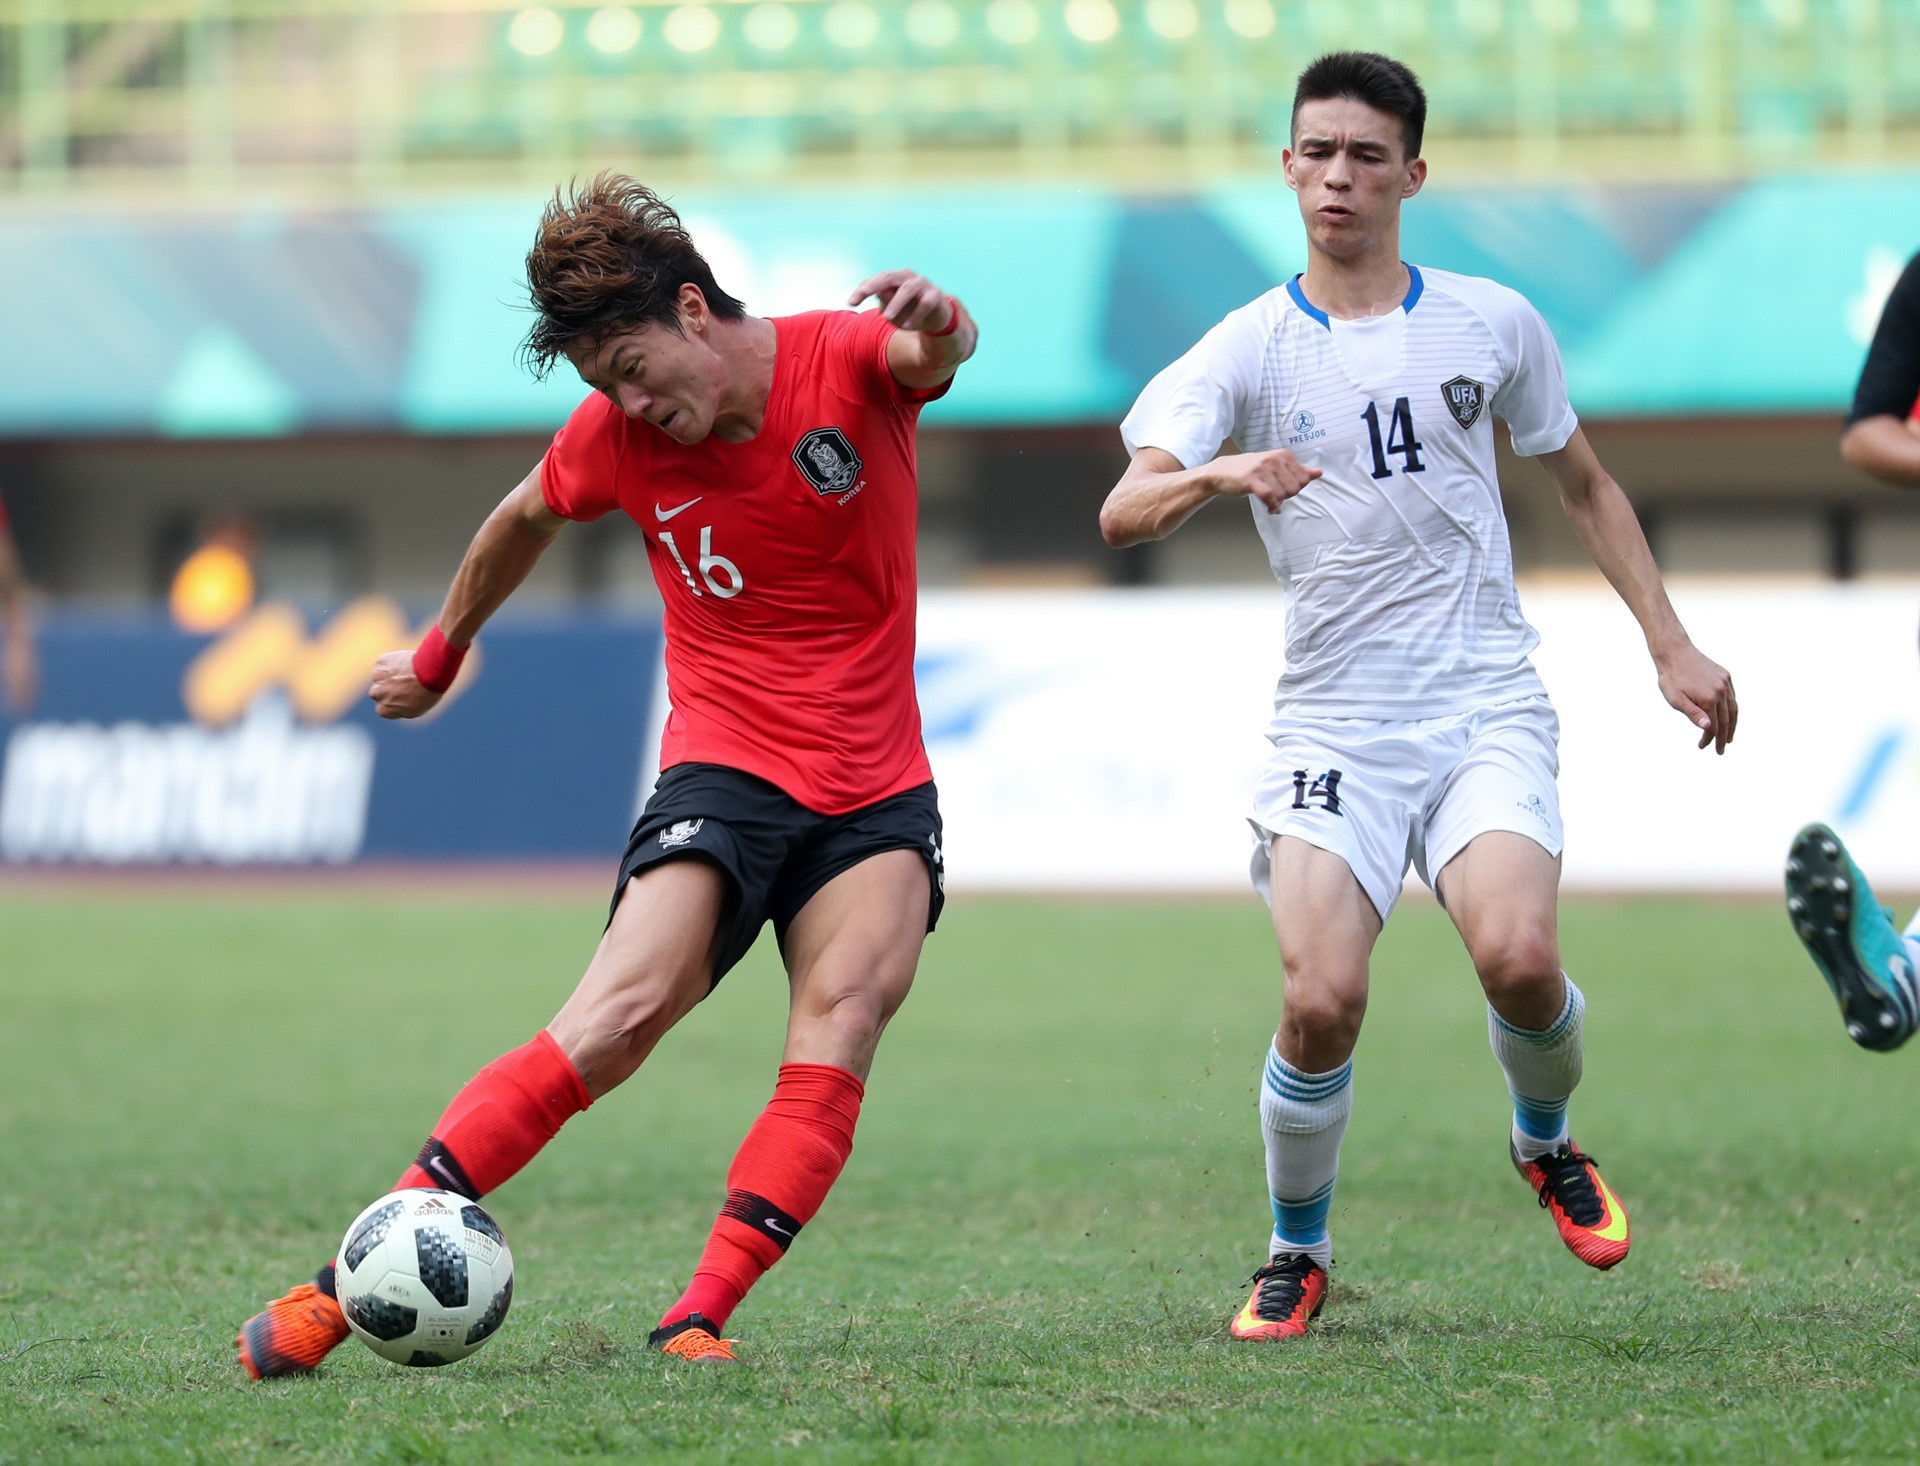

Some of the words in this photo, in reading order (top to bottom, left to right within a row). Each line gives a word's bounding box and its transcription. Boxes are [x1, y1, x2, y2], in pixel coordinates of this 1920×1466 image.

[1450, 387, 1478, 404] UFA
[1288, 429, 1326, 444] PRESJOG
[1360, 396, 1426, 479] 14
[837, 480, 867, 506] KOREA
[658, 525, 744, 599] 16
[414, 1208, 454, 1216] adidas
[464, 1229, 493, 1248] TELSTAR
